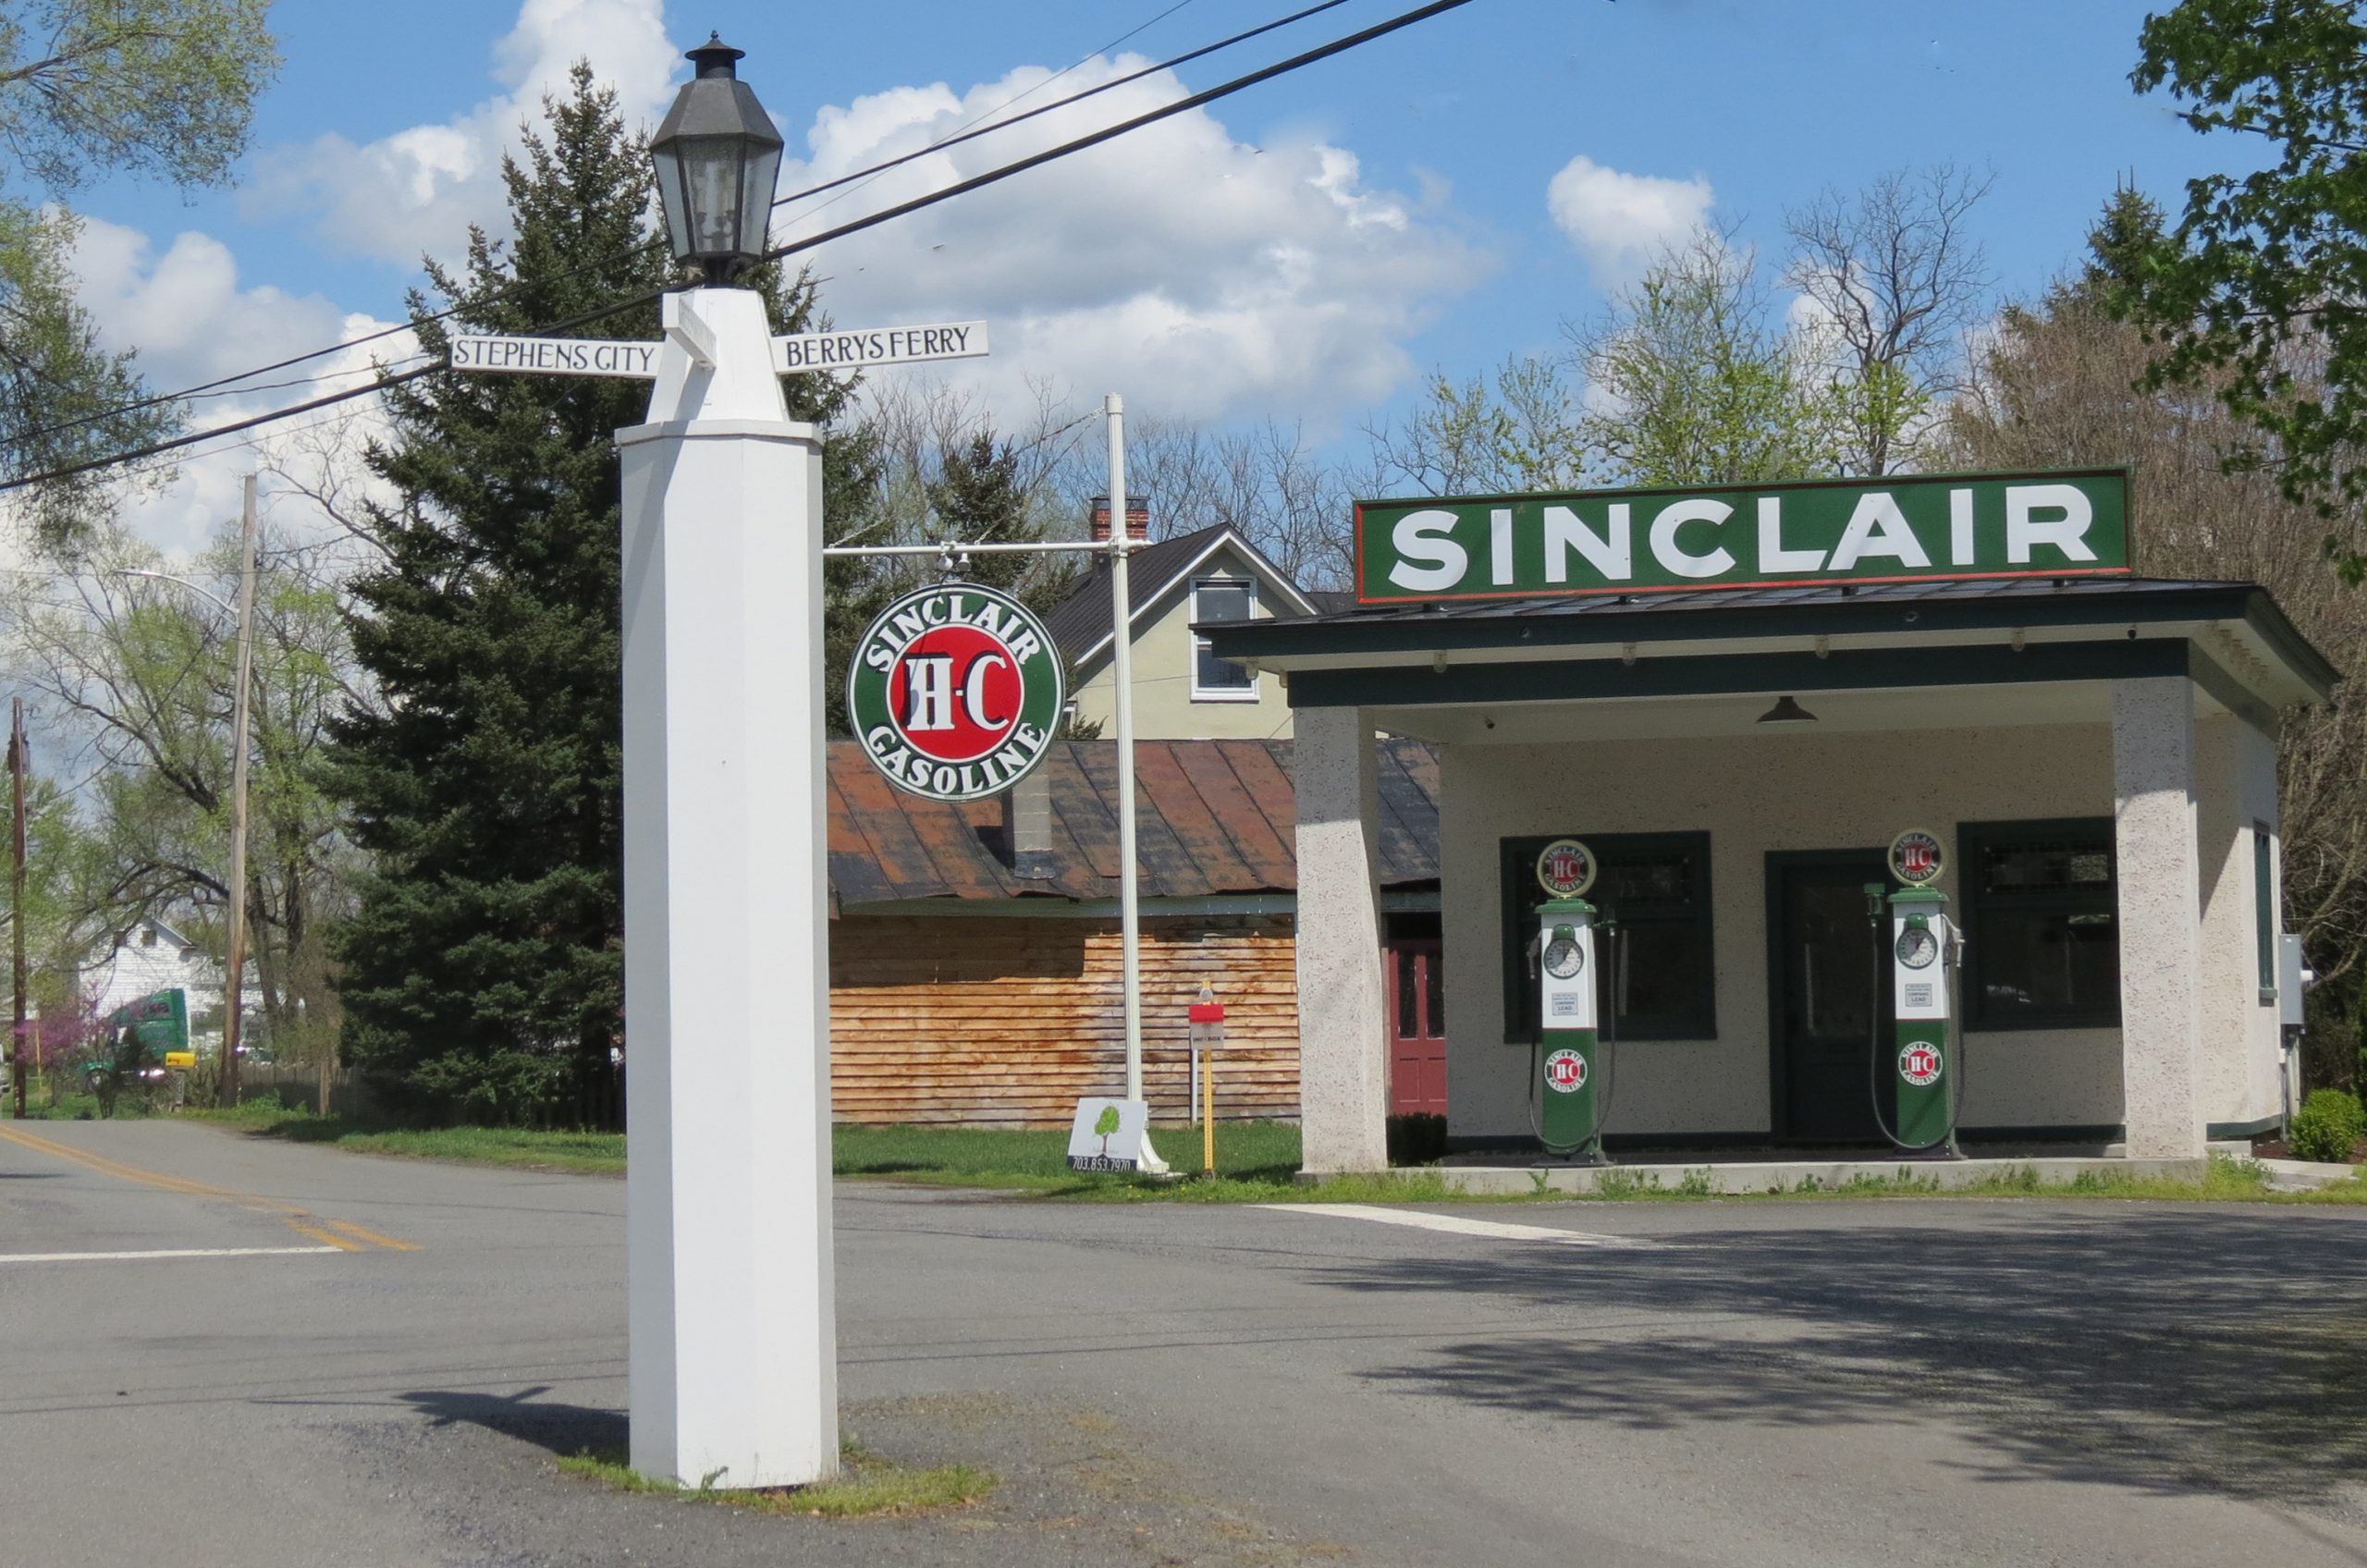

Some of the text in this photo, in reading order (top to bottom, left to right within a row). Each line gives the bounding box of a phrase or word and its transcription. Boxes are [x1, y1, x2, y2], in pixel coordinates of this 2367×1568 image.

[454, 339, 656, 372] STEPHENS CITY
[786, 326, 970, 367] BERRYS FERRY
[1388, 484, 2099, 592] SINCLAIR
[866, 594, 1040, 672] SINCLAIR
[868, 722, 1046, 794] GASOLINE
[1896, 835, 1937, 853] SINCLAIR
[1545, 847, 1585, 864] SINCLAIR
[1896, 862, 1939, 880] GASOLINE
[1545, 873, 1587, 891] GASOLINE
[1548, 1051, 1583, 1065] SINCLAIR
[1902, 1044, 1938, 1058] SINCLAIR
[1548, 1077, 1584, 1092] GASOLINE
[1902, 1070, 1939, 1084] GASOLINE
